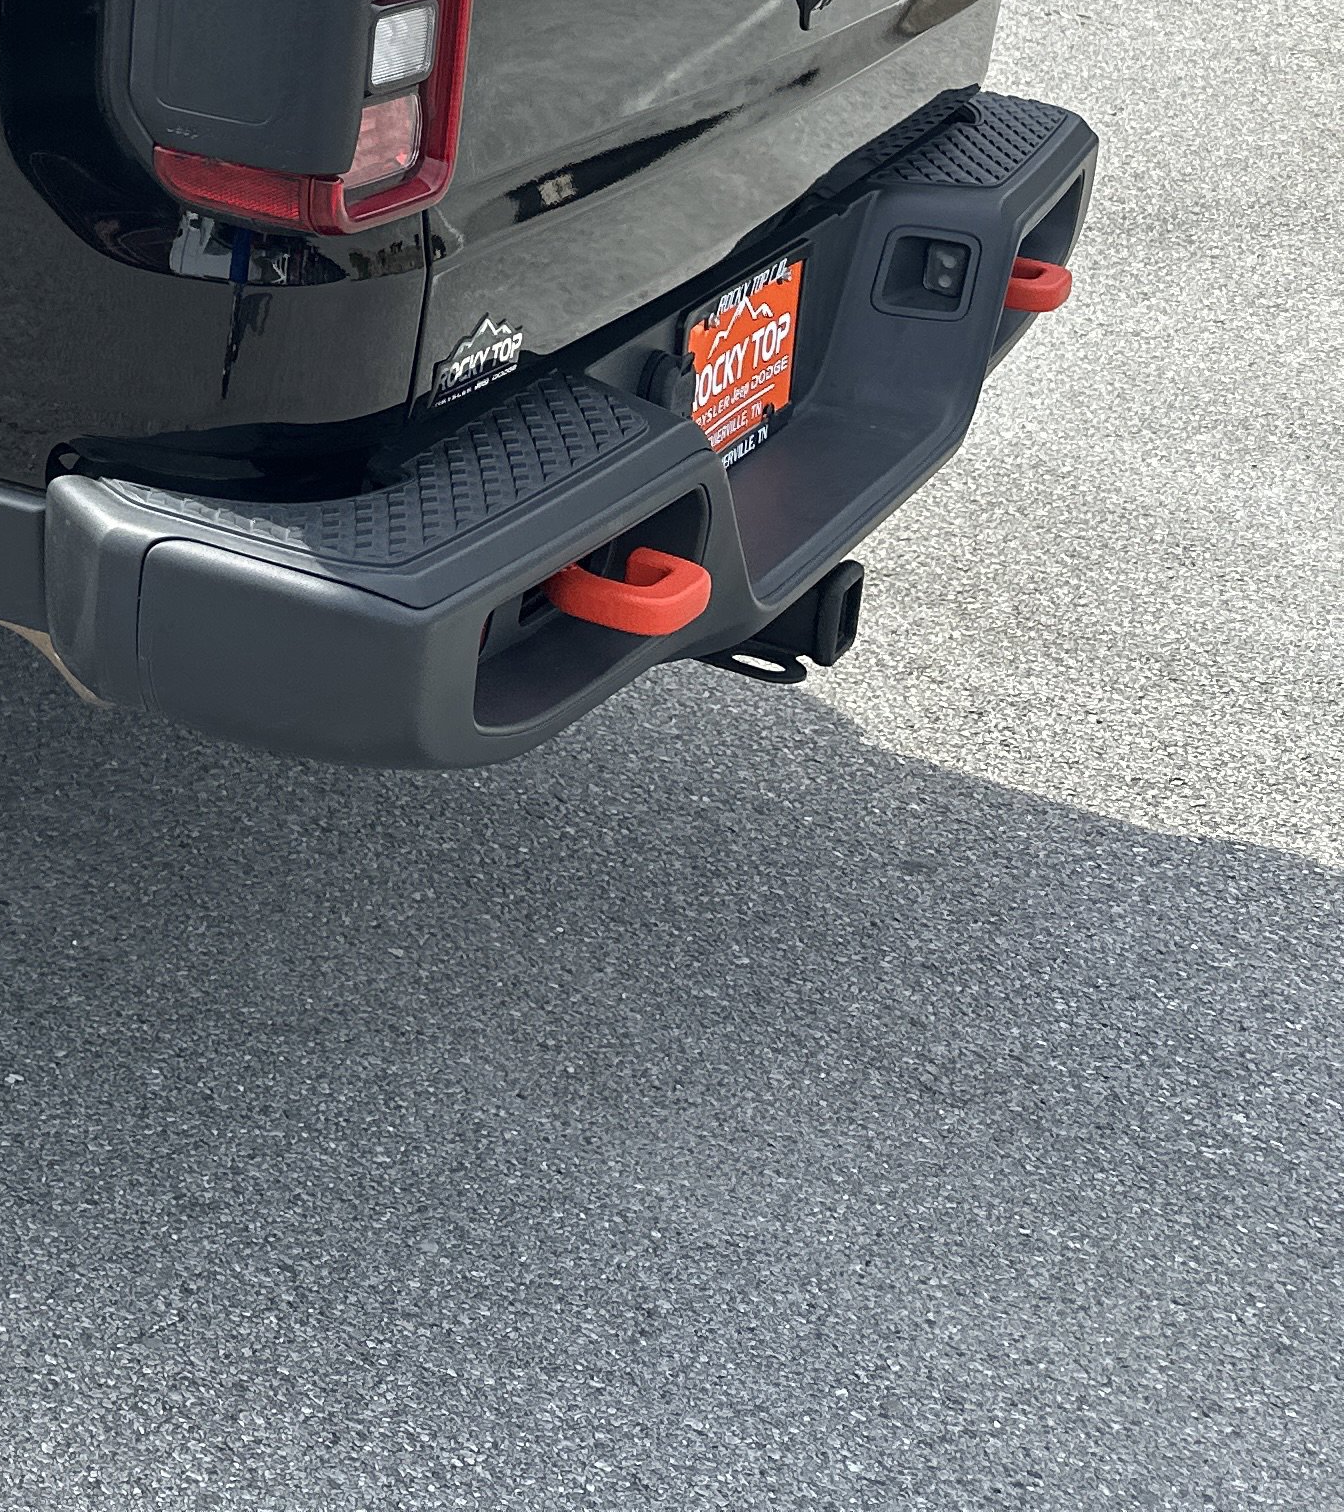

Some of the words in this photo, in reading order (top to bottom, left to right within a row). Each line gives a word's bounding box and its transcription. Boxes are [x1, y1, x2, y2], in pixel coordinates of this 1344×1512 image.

[438, 346, 492, 391] ROCKY
[491, 332, 523, 367] TOP
[752, 312, 792, 369] TOP
[750, 355, 790, 390] DODGE
[757, 424, 770, 443] TN
